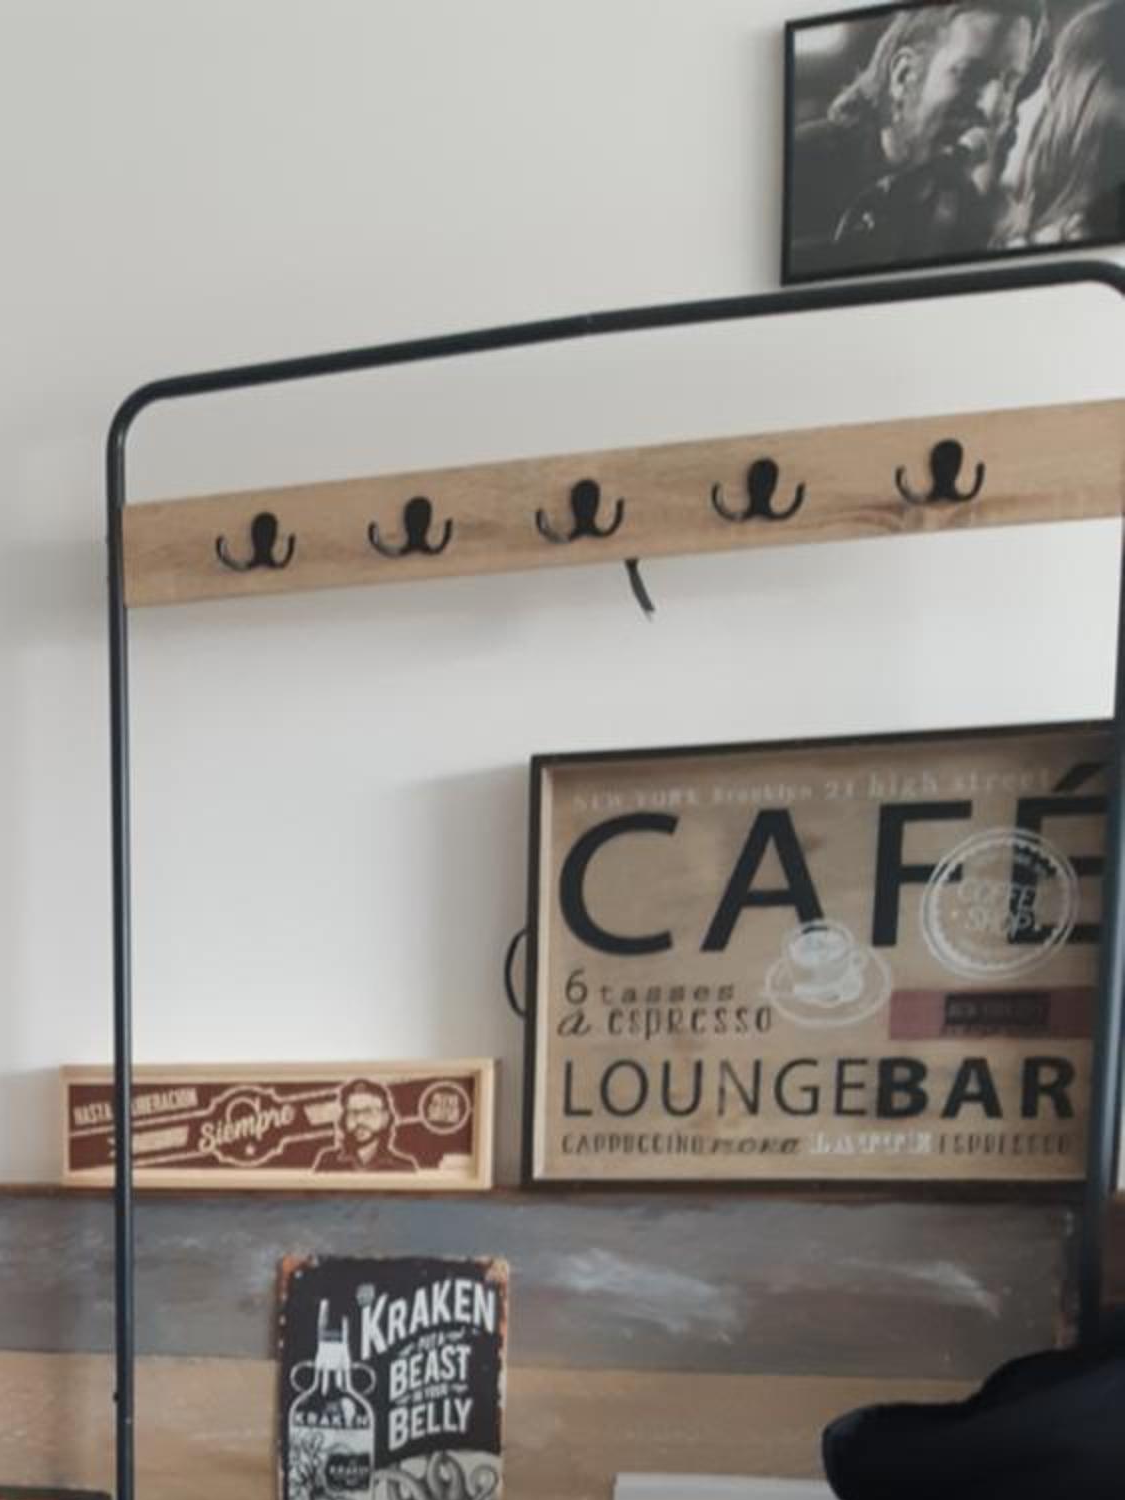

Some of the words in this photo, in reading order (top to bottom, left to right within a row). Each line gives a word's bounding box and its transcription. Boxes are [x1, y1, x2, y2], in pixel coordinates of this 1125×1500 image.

[558, 762, 1106, 956] CAFÉ
[565, 967, 588, 1005] 6
[563, 1056, 1075, 1120] LOUNGEBAR
[199, 1098, 296, 1153] Siempre
[360, 1279, 496, 1361] KRAKEN
[389, 1344, 472, 1402] BEAST
[388, 1397, 472, 1451] BELLY
